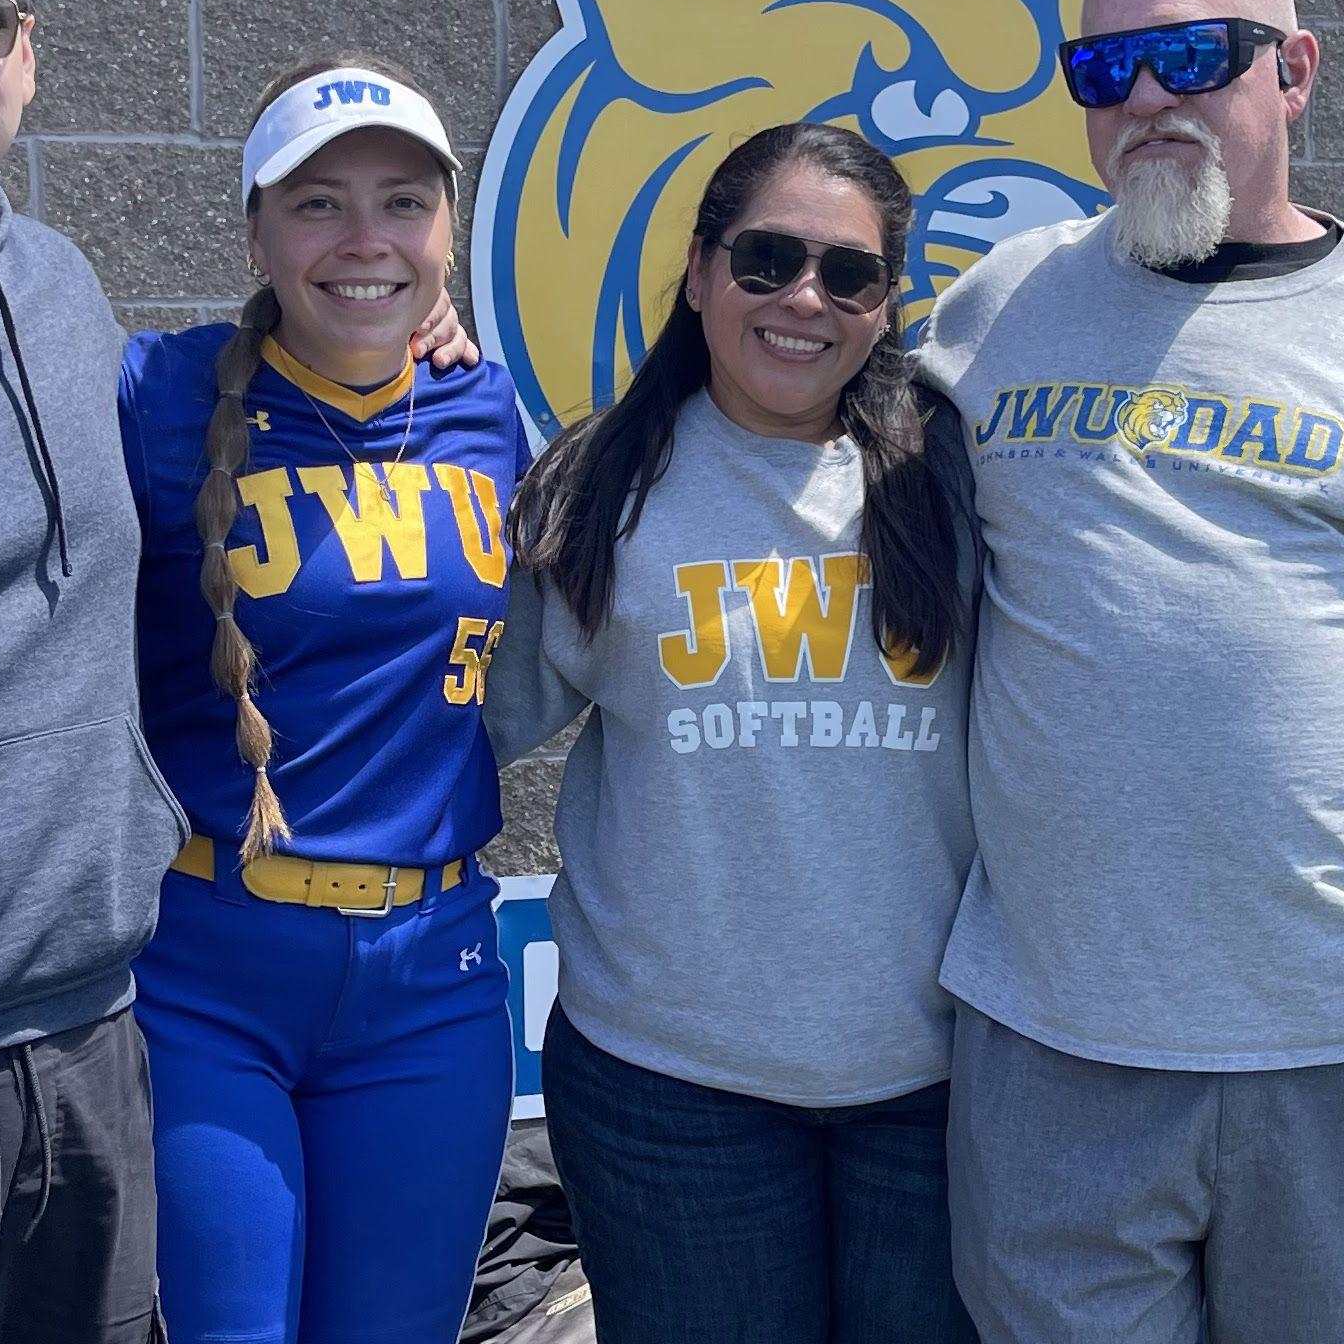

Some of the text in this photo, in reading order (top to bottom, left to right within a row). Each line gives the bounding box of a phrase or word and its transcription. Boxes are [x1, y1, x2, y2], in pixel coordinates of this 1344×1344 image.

[313, 80, 390, 110] JWU
[974, 384, 1129, 449] JWU
[227, 461, 507, 599] JWU
[667, 700, 942, 754] SOFTBALL
